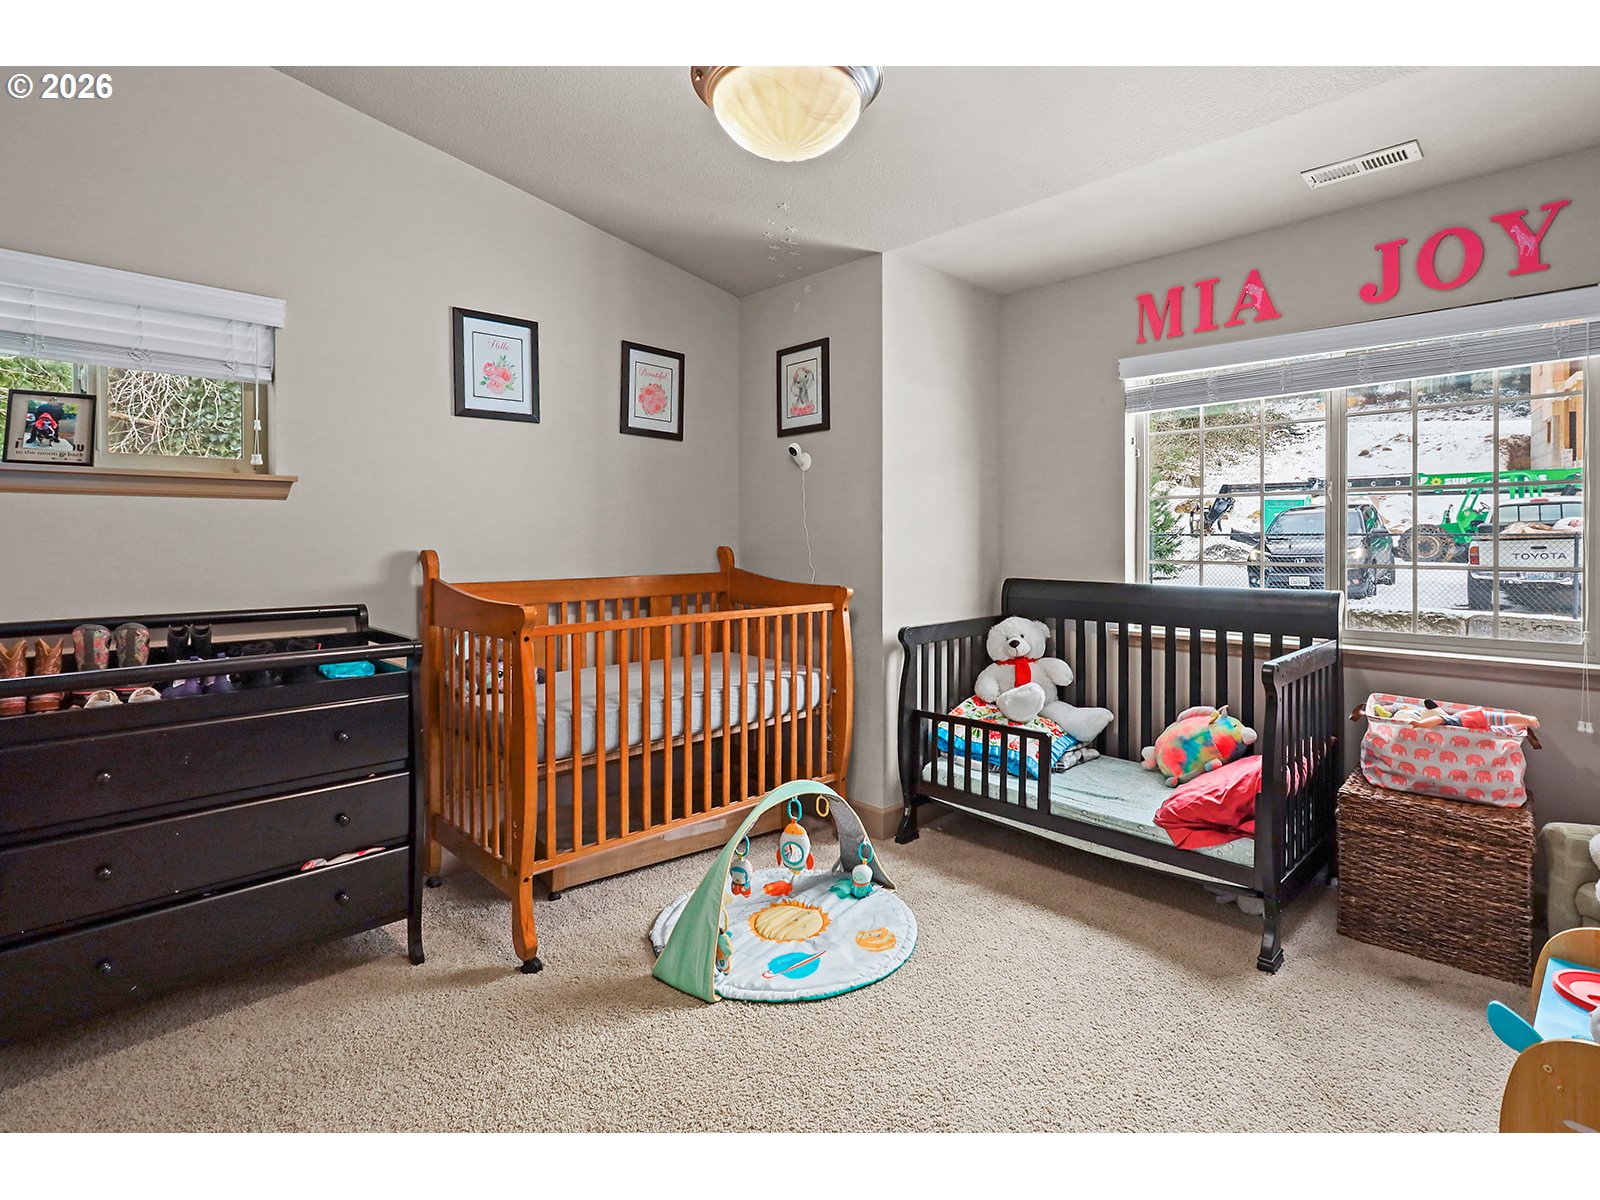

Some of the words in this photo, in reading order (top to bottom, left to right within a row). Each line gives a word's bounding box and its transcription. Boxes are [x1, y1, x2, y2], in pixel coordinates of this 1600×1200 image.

[1136, 268, 1281, 344] MIA
[1359, 199, 1571, 304] JOY
[1513, 552, 1567, 560] TOYOTA
